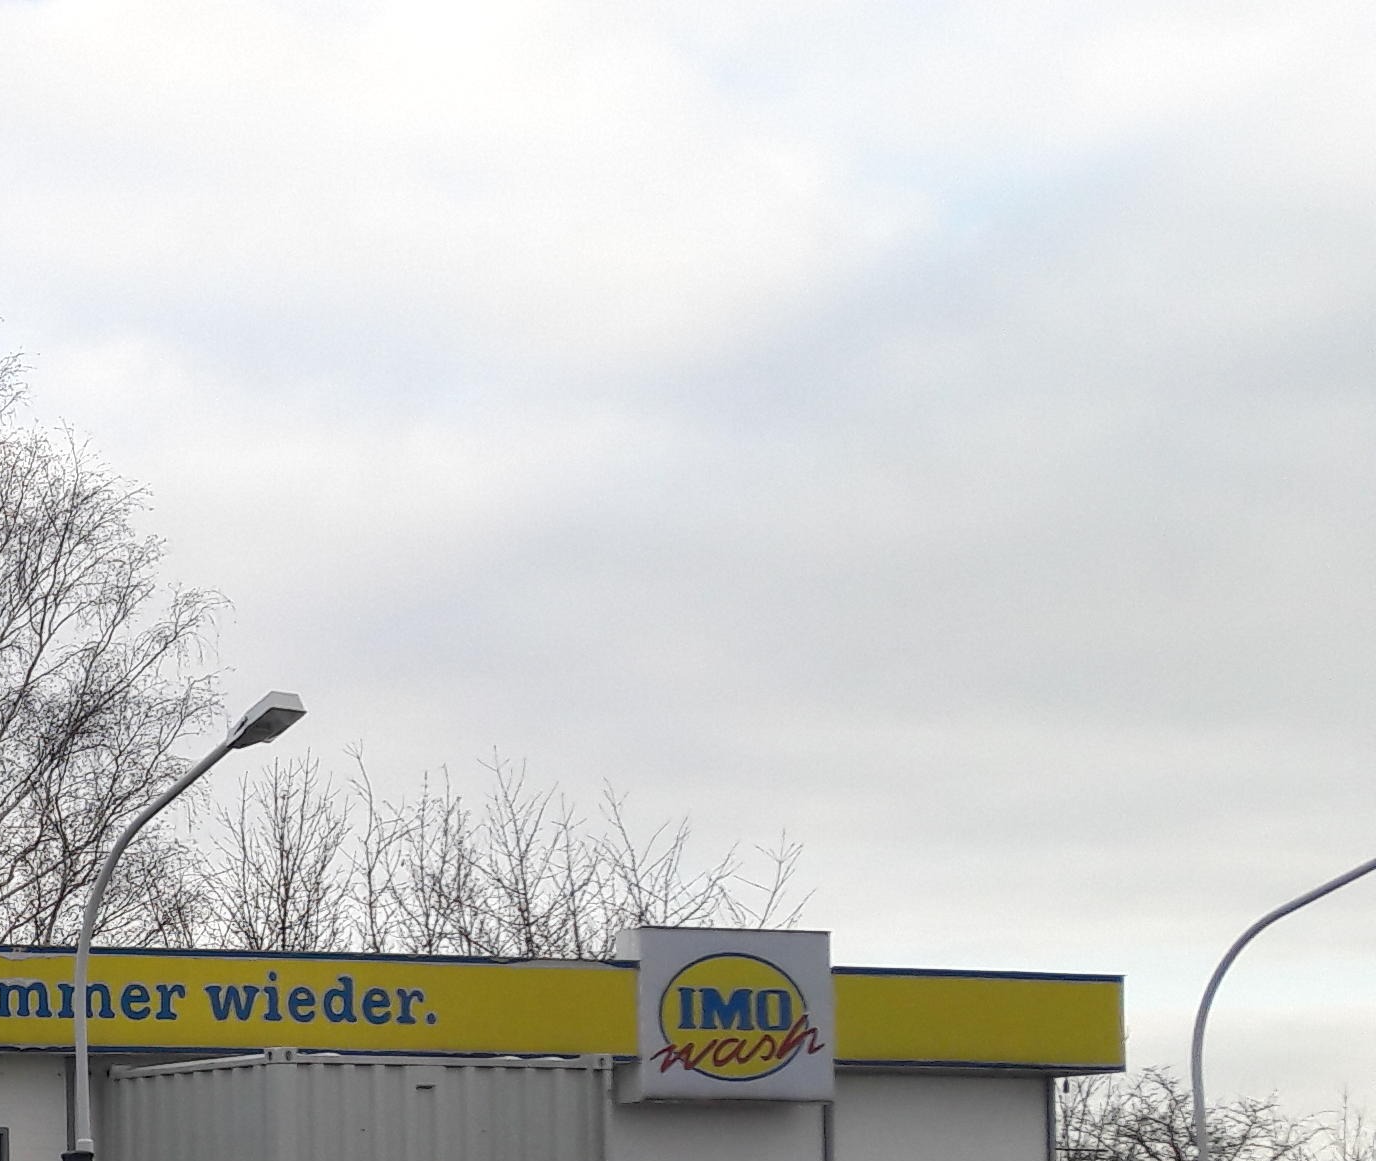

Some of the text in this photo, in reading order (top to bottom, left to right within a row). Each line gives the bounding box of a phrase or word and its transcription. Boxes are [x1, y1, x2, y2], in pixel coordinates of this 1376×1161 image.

[203, 970, 438, 1025] wieder.
[677, 986, 793, 1031] IMO
[650, 1014, 825, 1073] wash
